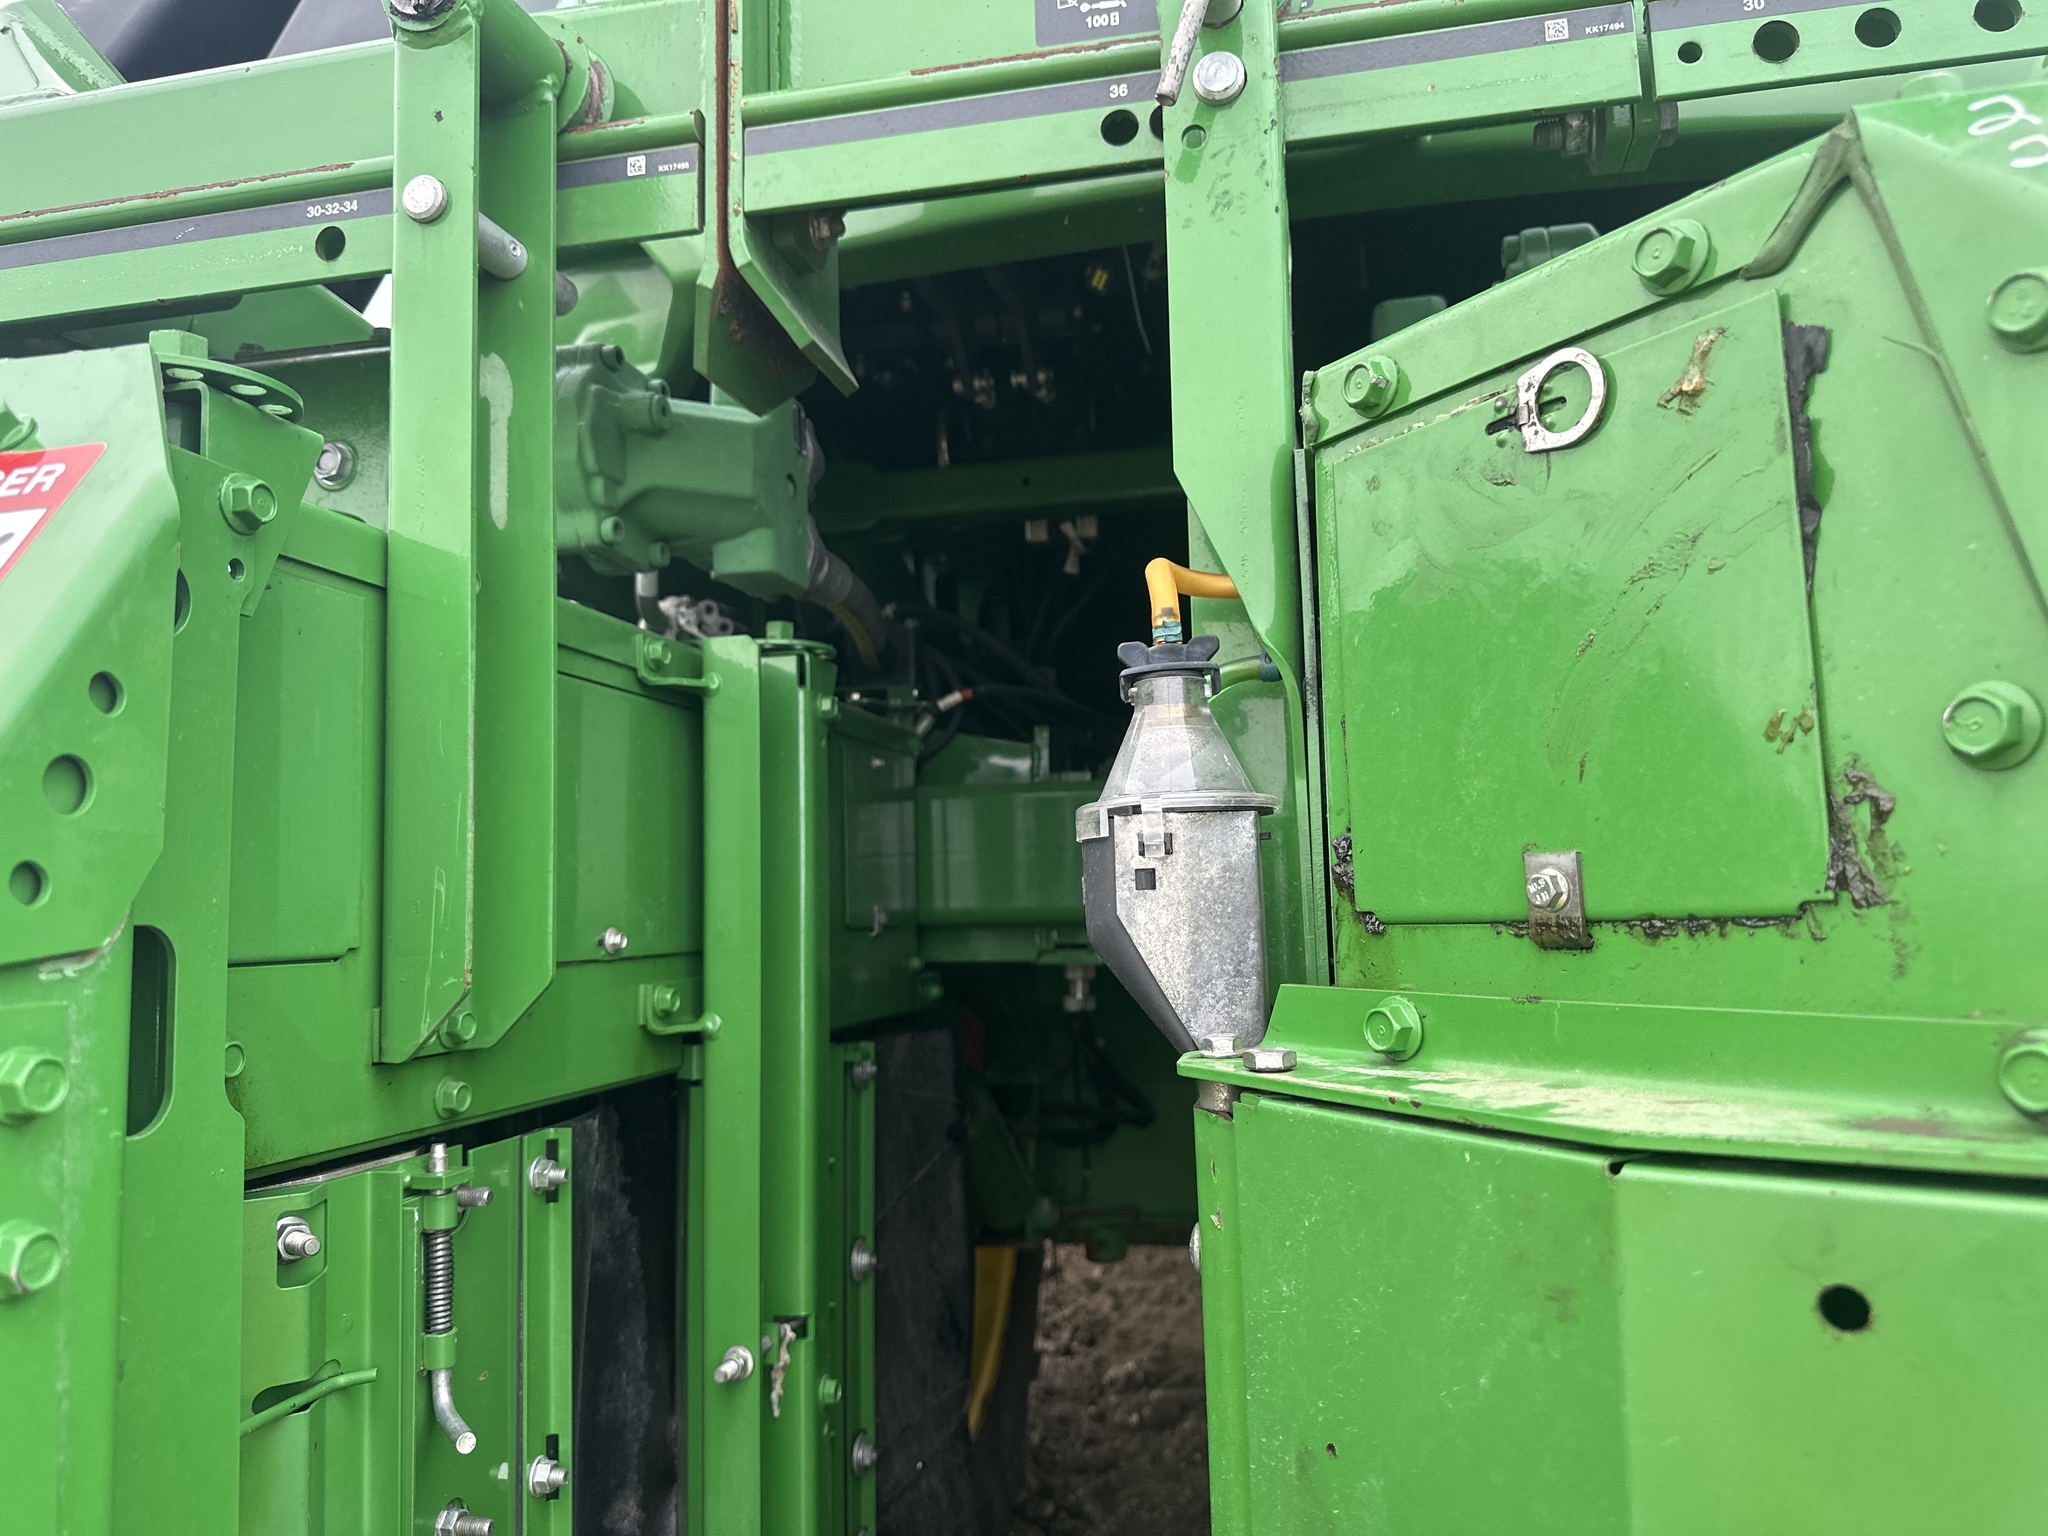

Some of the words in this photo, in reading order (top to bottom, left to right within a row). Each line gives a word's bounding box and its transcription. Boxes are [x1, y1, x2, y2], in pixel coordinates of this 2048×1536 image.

[1742, 0, 1765, 12] 30
[1085, 13, 1109, 29] 100
[1585, 21, 1625, 34] KK17494
[1109, 83, 1128, 98] 36
[306, 199, 358, 218] 30-32-34
[0, 462, 67, 498] ER
